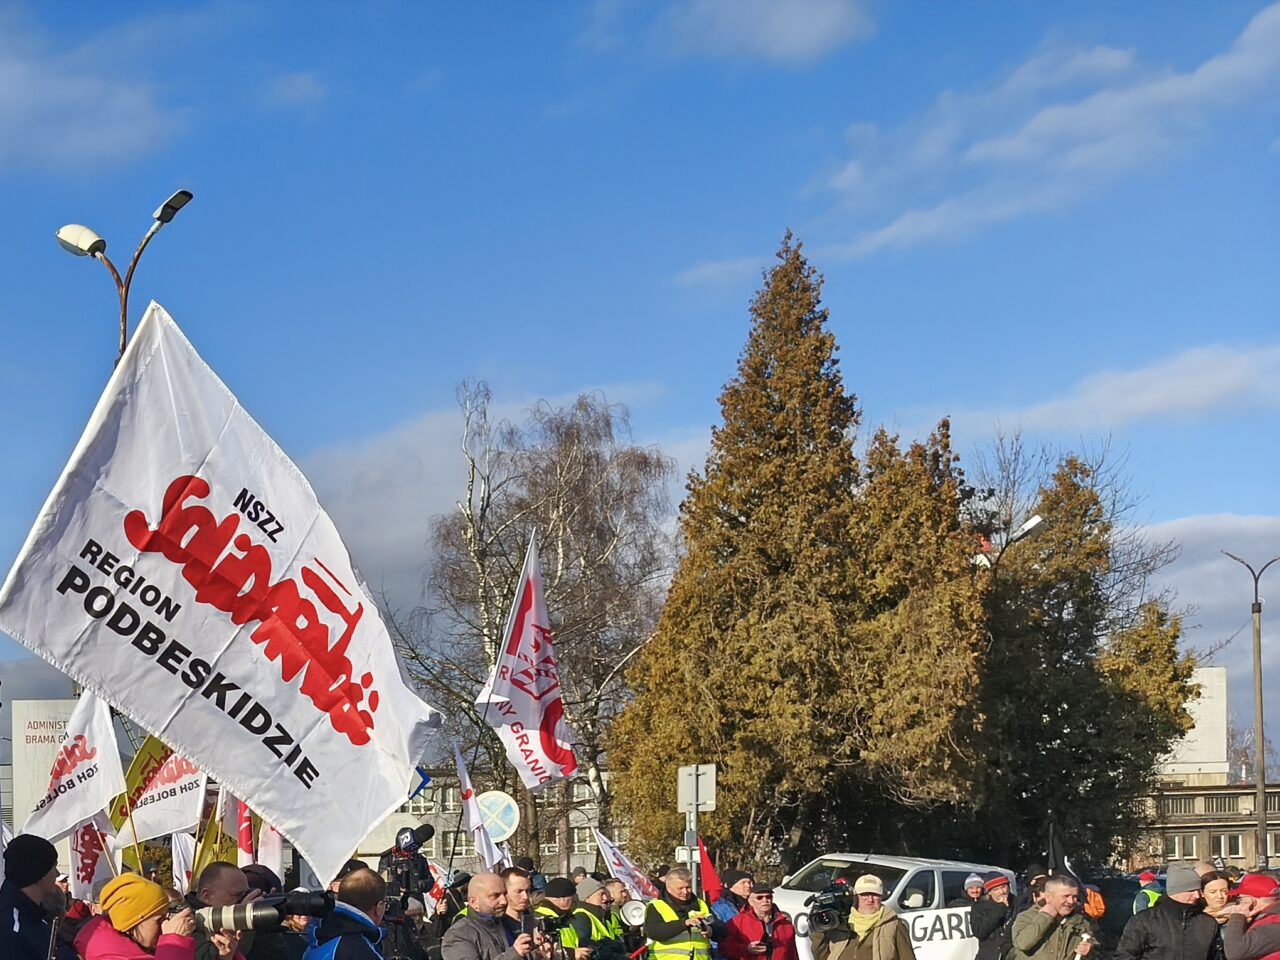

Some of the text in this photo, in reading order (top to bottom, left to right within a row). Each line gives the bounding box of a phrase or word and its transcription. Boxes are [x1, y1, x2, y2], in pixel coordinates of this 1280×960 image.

[232, 487, 285, 544] NSZZ
[79, 538, 182, 623] REGION
[56, 565, 320, 790] PODBESKIDZIE
[25, 735, 56, 744] BRAMA
